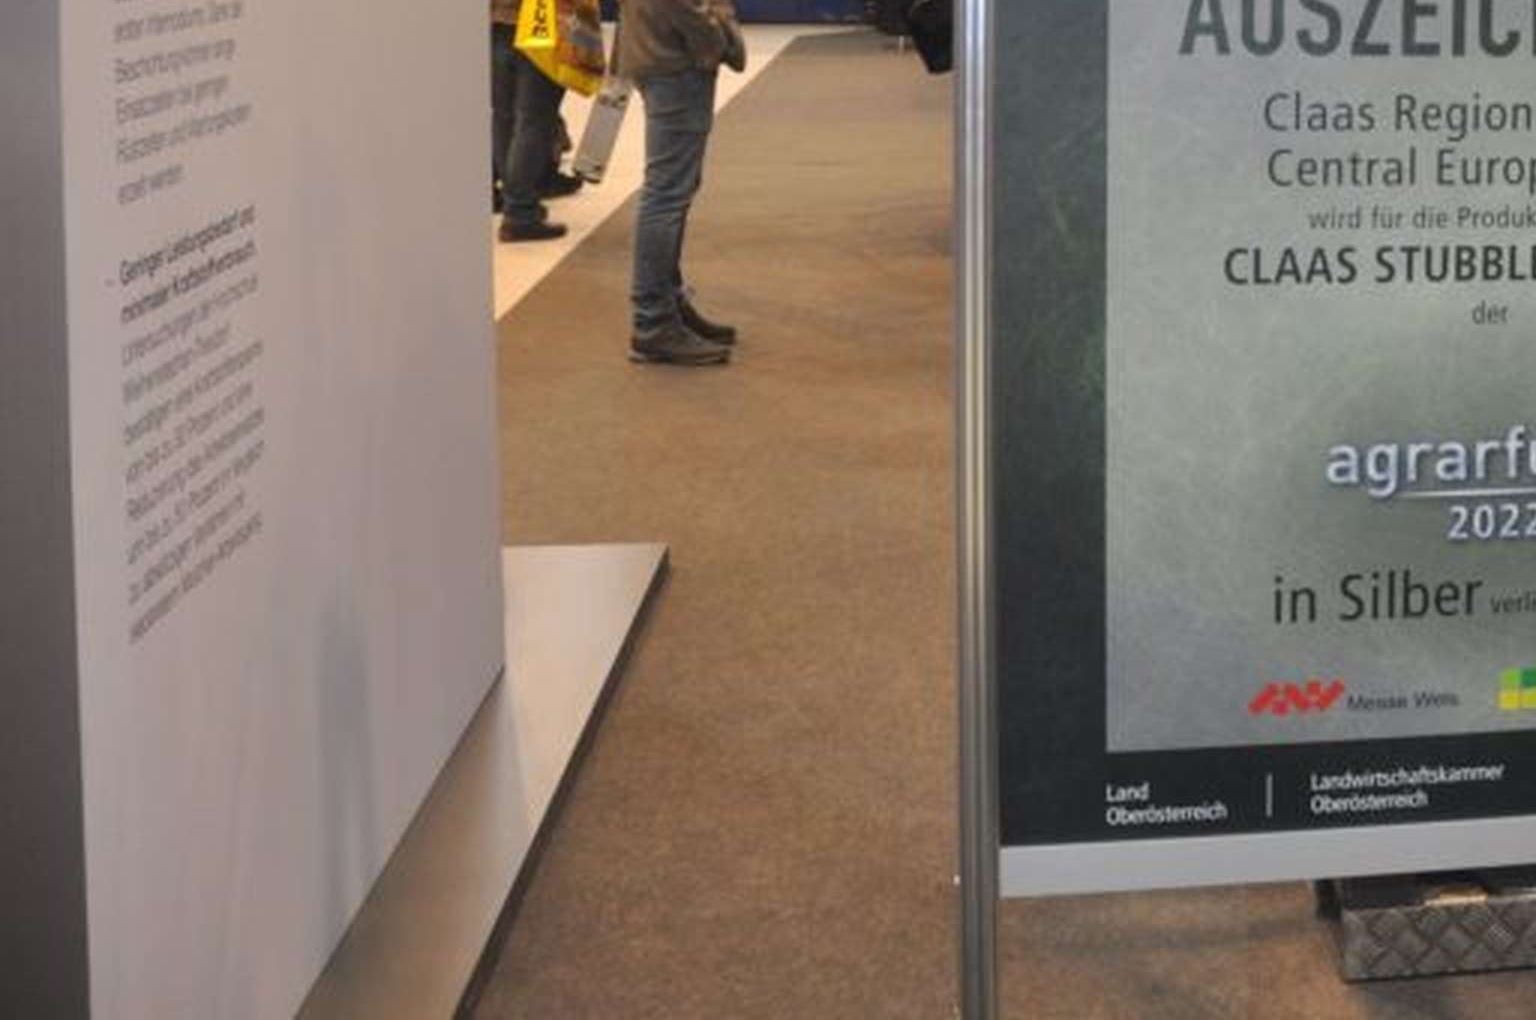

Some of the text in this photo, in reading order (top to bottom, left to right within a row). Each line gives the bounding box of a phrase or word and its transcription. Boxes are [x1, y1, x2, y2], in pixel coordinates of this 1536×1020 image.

[1264, 92, 1375, 132] Claas
[1267, 148, 1417, 187] Central
[1308, 207, 1362, 229] wird
[1371, 206, 1403, 229] für
[1412, 207, 1448, 229] die
[1224, 247, 1358, 286] CLAAS
[1471, 301, 1509, 325] der
[1274, 575, 1318, 625] in
[1340, 570, 1483, 622] Silber
[1311, 764, 1505, 791] Landwirtschaftskammer
[1106, 782, 1149, 802] Land
[1310, 790, 1429, 815] Oberösterreich
[1106, 801, 1228, 827] Oberösterreich
